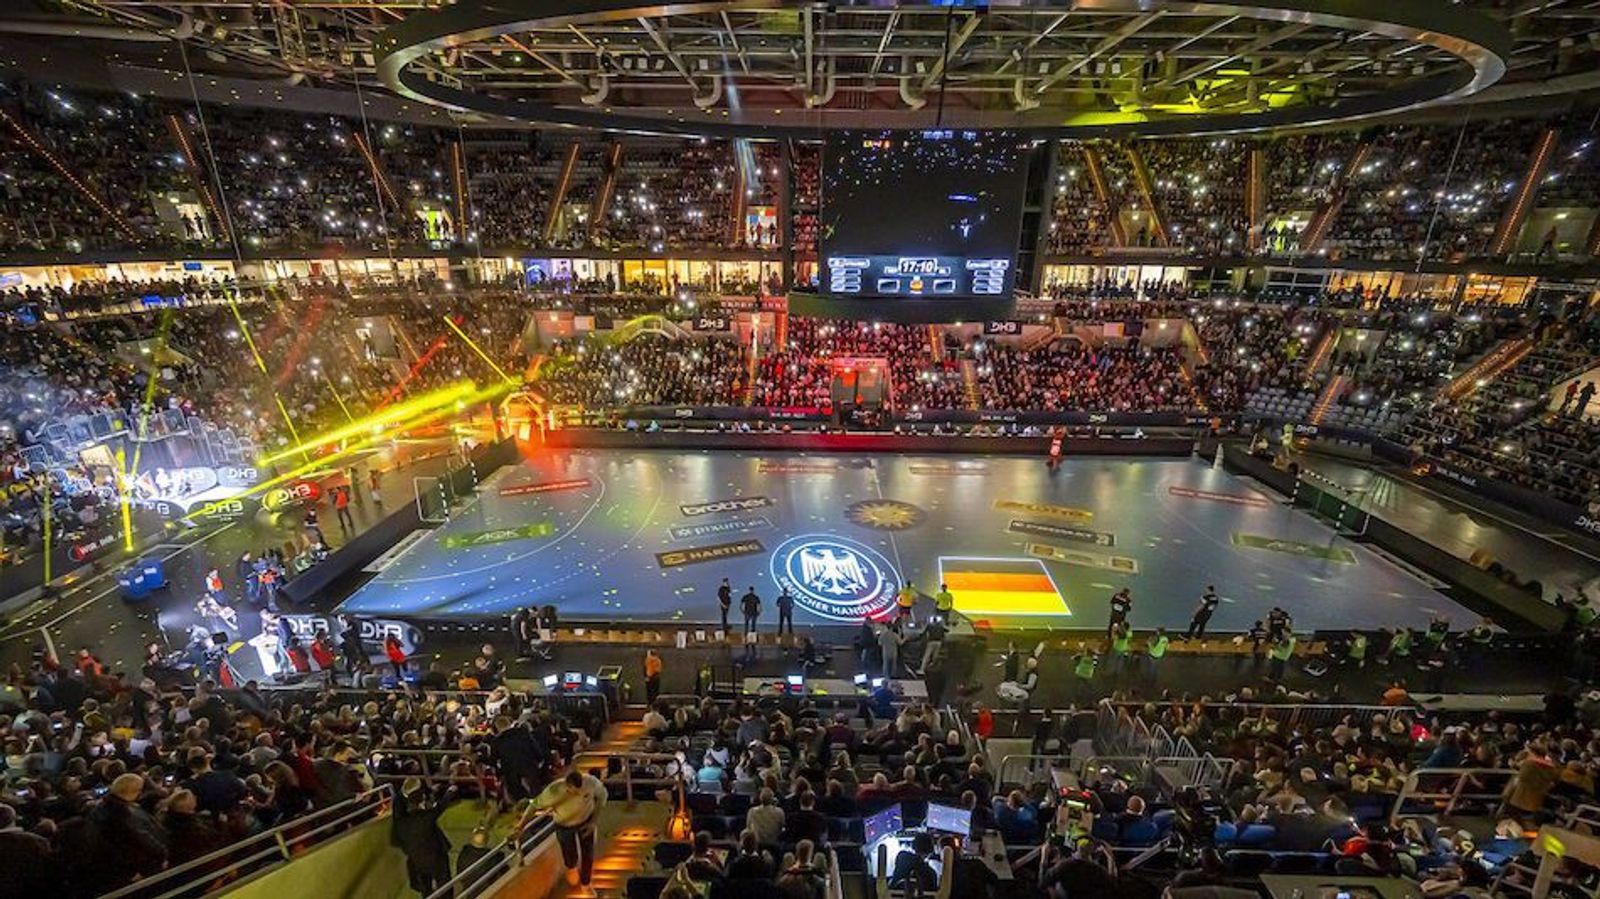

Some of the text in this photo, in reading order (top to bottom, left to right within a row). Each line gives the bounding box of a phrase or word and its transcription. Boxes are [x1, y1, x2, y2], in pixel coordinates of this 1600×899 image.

[902, 260, 934, 273] 17:10
[682, 499, 766, 515] brother
[689, 543, 759, 559] HARTING
